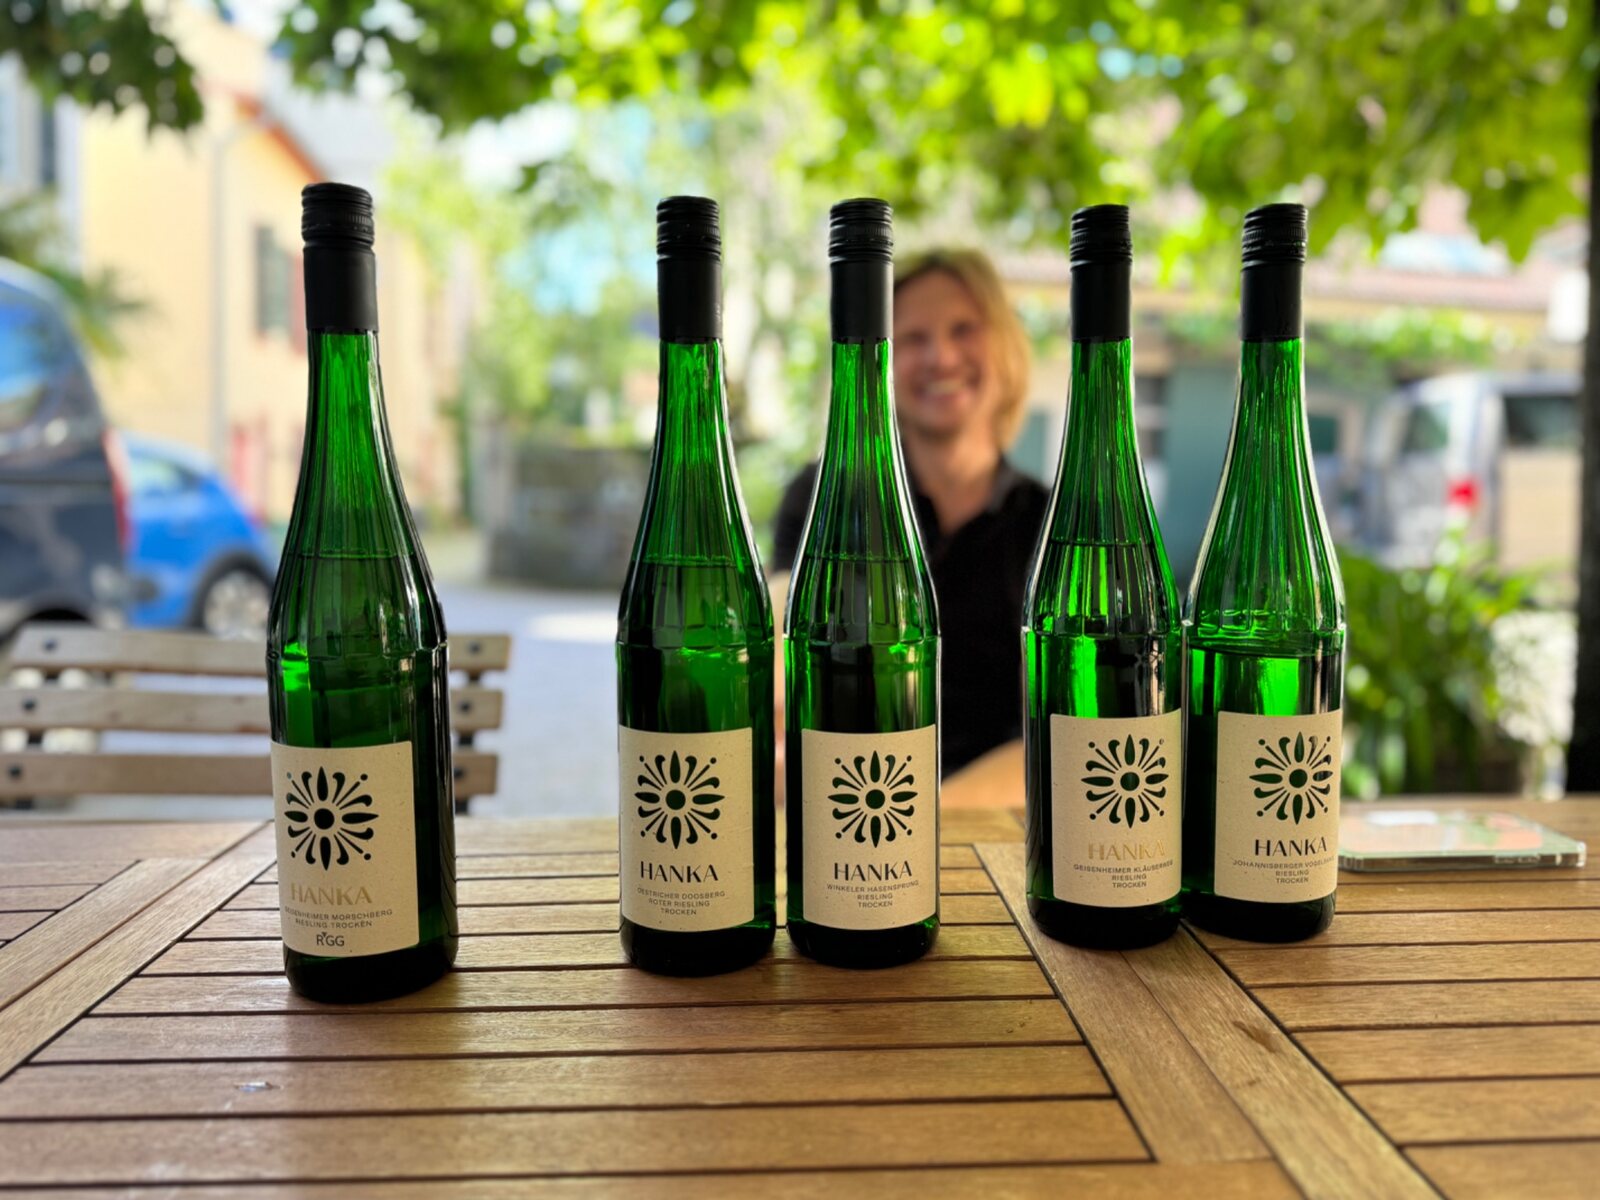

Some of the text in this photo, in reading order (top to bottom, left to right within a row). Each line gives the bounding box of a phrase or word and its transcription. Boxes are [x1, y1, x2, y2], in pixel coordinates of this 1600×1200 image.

[1088, 840, 1165, 860] HANKA
[1254, 837, 1327, 856] HANKA
[1073, 864, 1131, 873] GEISENHEIMER
[1233, 859, 1302, 869] JOHANNISBERGER
[640, 860, 718, 883] HANKA
[834, 860, 912, 881] HANKA
[826, 880, 919, 892] WINKELER HASENSPRUNG
[291, 884, 372, 906] HANKA
[637, 887, 725, 899] OESTRICHER DOOSBERG
[648, 899, 672, 907] ROTER
[332, 909, 393, 920] MORSCHBERG
[295, 918, 372, 928] RIESLING TROCKEN
